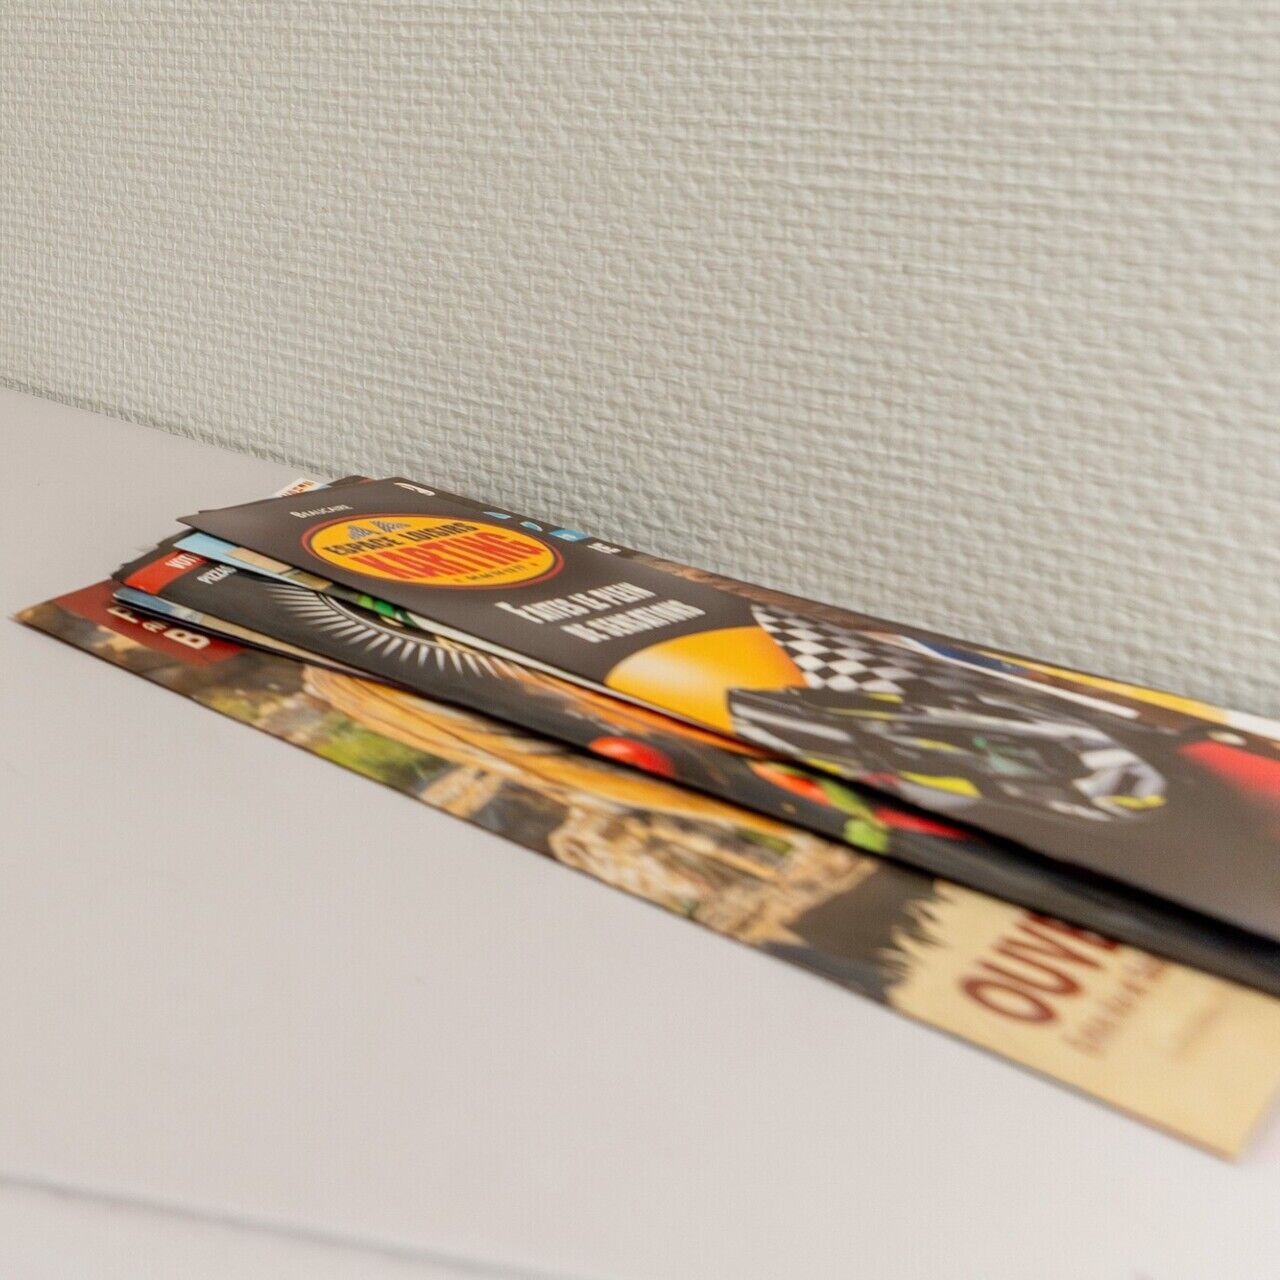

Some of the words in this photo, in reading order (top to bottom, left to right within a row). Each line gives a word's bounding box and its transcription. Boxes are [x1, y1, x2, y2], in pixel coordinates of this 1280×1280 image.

[323, 535, 404, 556] ESPACE
[399, 522, 480, 543] LOISIRS
[346, 531, 545, 580] KARTING
[568, 592, 612, 611] LE
[587, 581, 658, 606] PLEIN
[560, 623, 612, 644] DE
[586, 599, 707, 638] SENSATIONS
